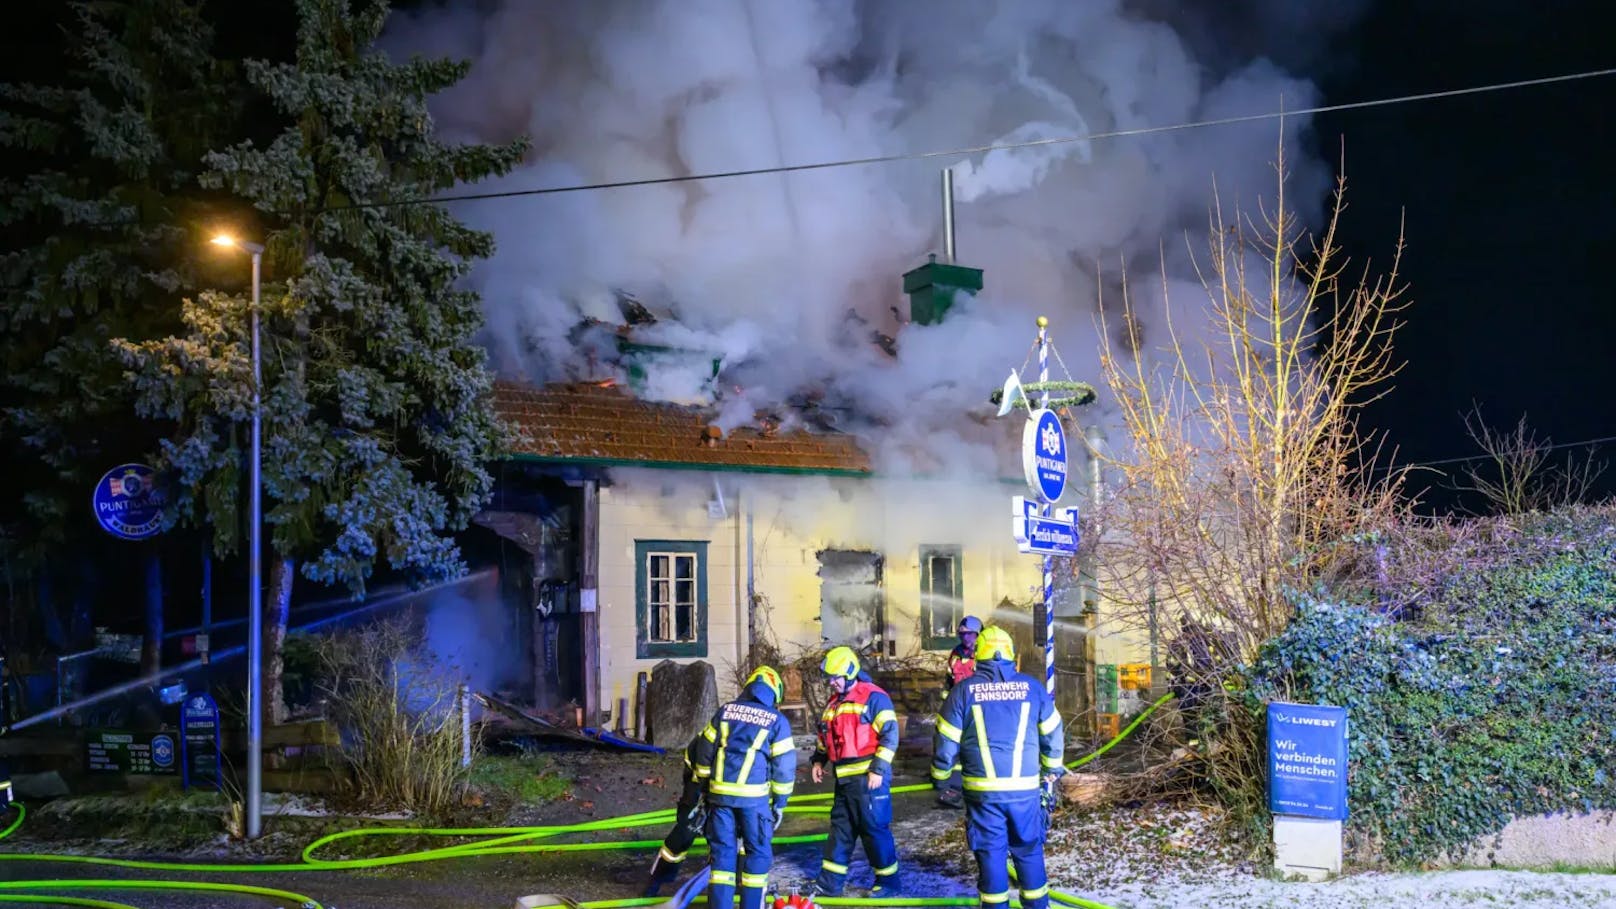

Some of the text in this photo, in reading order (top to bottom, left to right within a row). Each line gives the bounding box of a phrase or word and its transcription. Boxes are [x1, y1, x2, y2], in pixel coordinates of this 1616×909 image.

[969, 681, 1030, 694] FEUERWEHR
[974, 690, 1028, 702] ENNSDORF
[722, 711, 772, 727] ENNSDORF
[1292, 716, 1337, 728] LIWEST
[1275, 739, 1297, 751] Wir
[1275, 752, 1336, 766] verbinden
[1275, 762, 1338, 778] Menschen.
